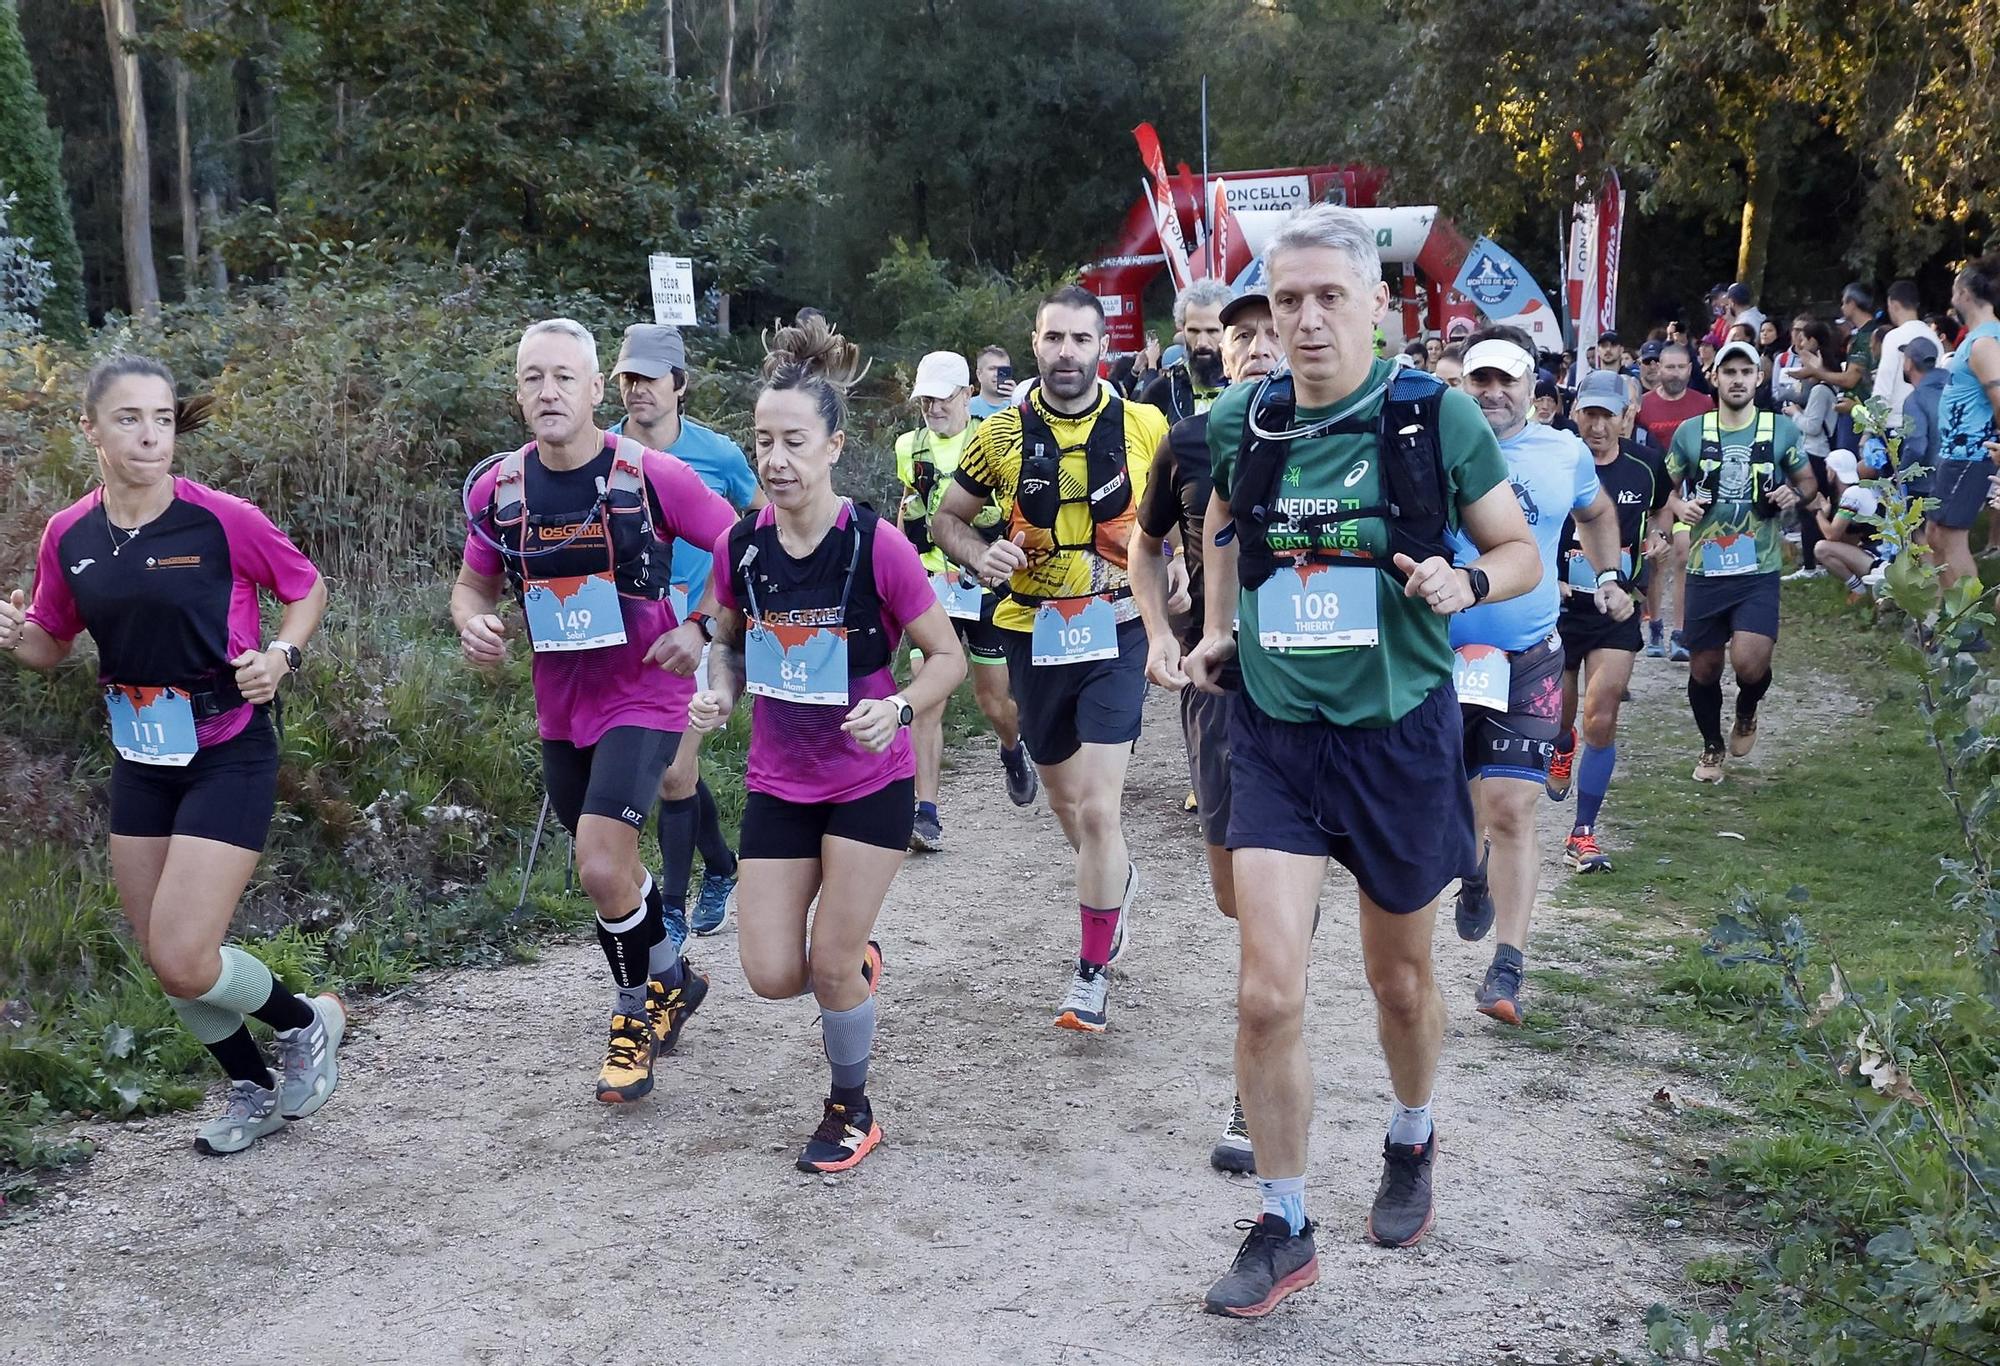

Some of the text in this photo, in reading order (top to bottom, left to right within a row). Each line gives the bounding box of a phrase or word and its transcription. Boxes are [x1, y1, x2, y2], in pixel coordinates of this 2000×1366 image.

[1226, 185, 1301, 202] ONCELLO
[660, 277, 679, 289] TECOR
[654, 292, 691, 305] SOCIETARIO
[1276, 498, 1338, 516] NEIDER
[1719, 553, 1740, 566] 121
[1291, 592, 1340, 620] 108
[555, 609, 592, 630] 149
[1295, 620, 1335, 632] THIERRY
[566, 630, 586, 640] Sabri
[1058, 626, 1092, 647] 105
[1065, 645, 1085, 655] Javier
[780, 660, 808, 682] 84
[783, 681, 807, 692] Mami
[1457, 671, 1489, 689] 165
[131, 721, 165, 744] 111
